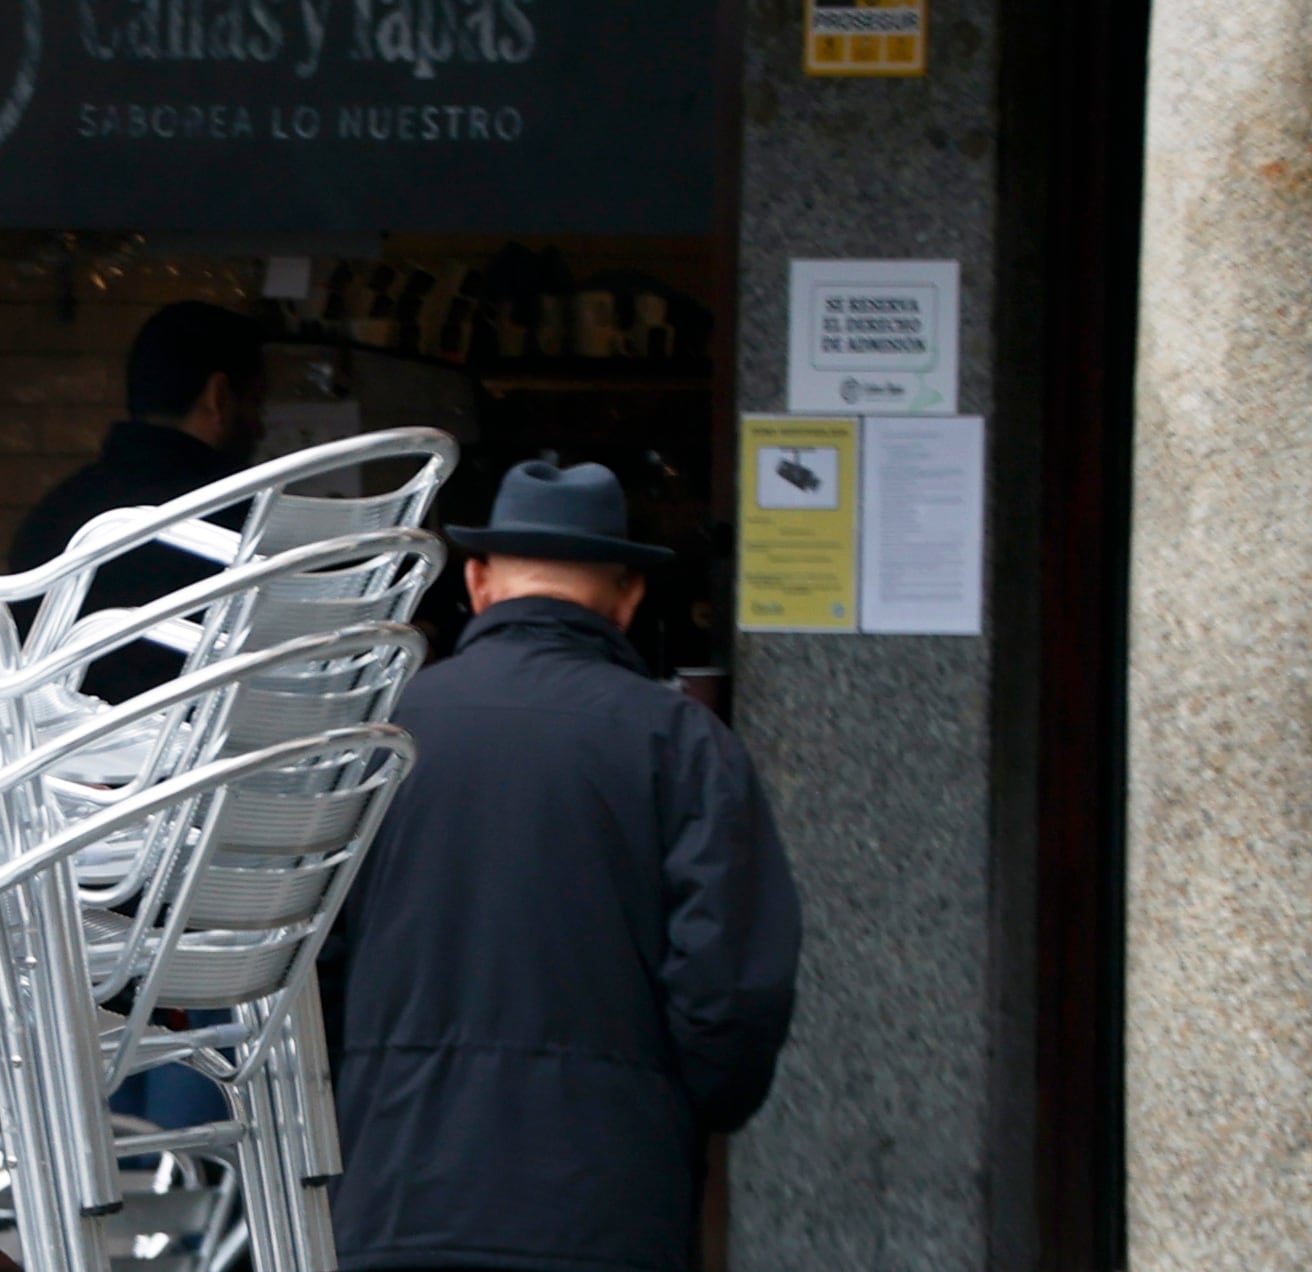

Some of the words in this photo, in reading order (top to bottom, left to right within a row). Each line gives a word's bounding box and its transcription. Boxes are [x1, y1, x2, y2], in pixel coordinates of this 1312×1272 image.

[78, 103, 254, 140] SABOREA
[271, 103, 322, 140] LO
[337, 103, 524, 141] NUESTRO
[847, 297, 921, 314] RESERVA
